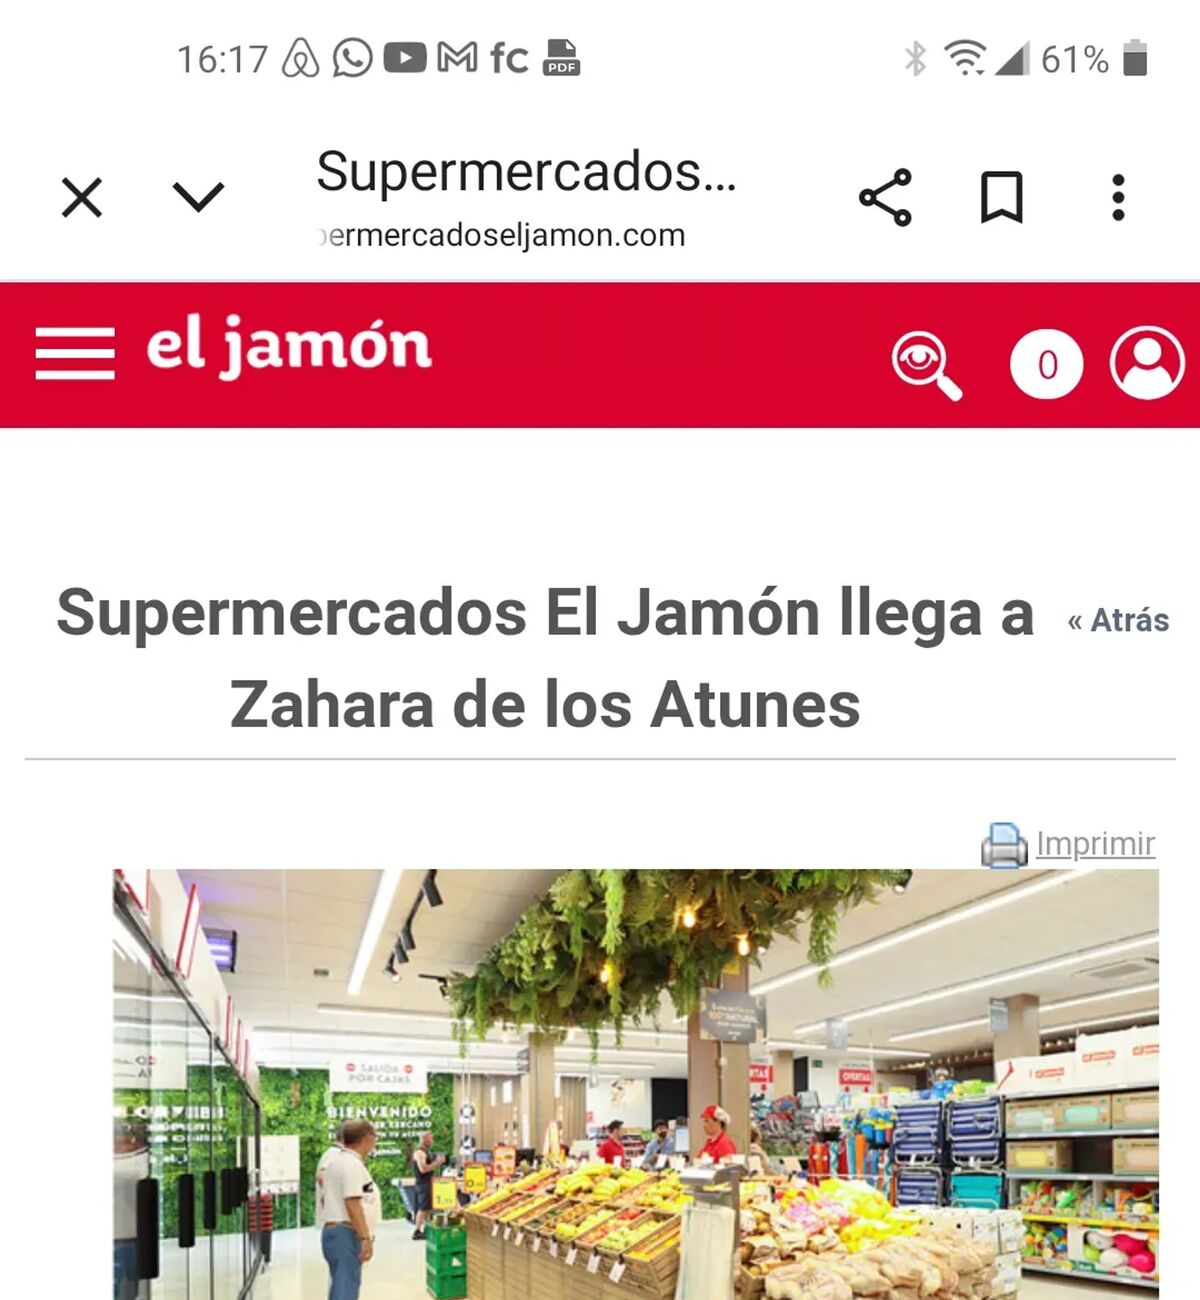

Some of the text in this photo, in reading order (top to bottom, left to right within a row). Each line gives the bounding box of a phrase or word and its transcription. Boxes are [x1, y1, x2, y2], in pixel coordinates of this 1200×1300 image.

[178, 45, 269, 74] 16:17
[548, 62, 576, 73] PDF
[1042, 44, 1110, 74] 61%
[146, 312, 433, 382] el jamón
[1039, 350, 1058, 379] 0
[57, 585, 1035, 649] Supermercados El Jamón llega a
[1090, 606, 1170, 633] Atrás
[230, 677, 860, 729] Zahara de los Atunes
[1036, 829, 1156, 863] Imprimir
[326, 1105, 433, 1119] BIENVENIDO
